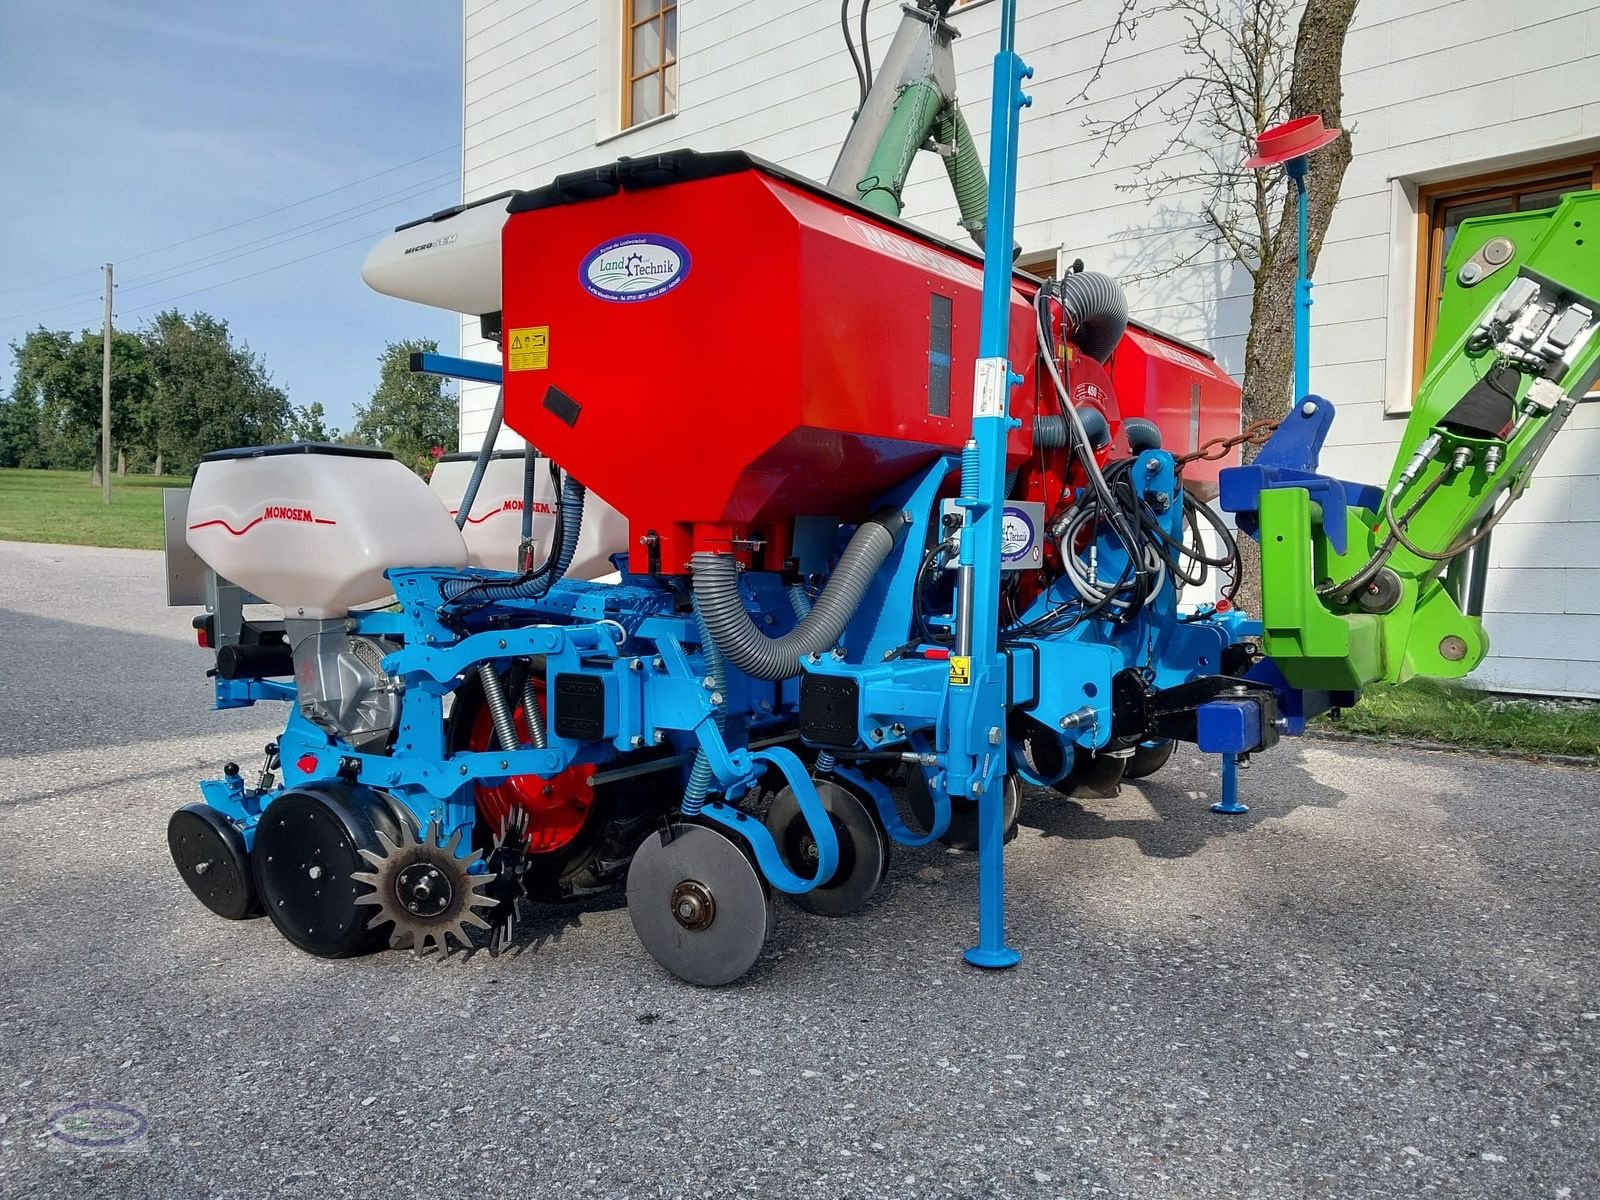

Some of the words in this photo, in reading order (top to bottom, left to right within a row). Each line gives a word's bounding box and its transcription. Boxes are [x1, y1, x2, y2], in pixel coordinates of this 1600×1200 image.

[404, 233, 458, 255] MICROSEM
[599, 256, 625, 272] Land
[633, 260, 674, 276] Technik
[263, 506, 313, 522] MONOSEM
[502, 500, 551, 514] MONSEM
